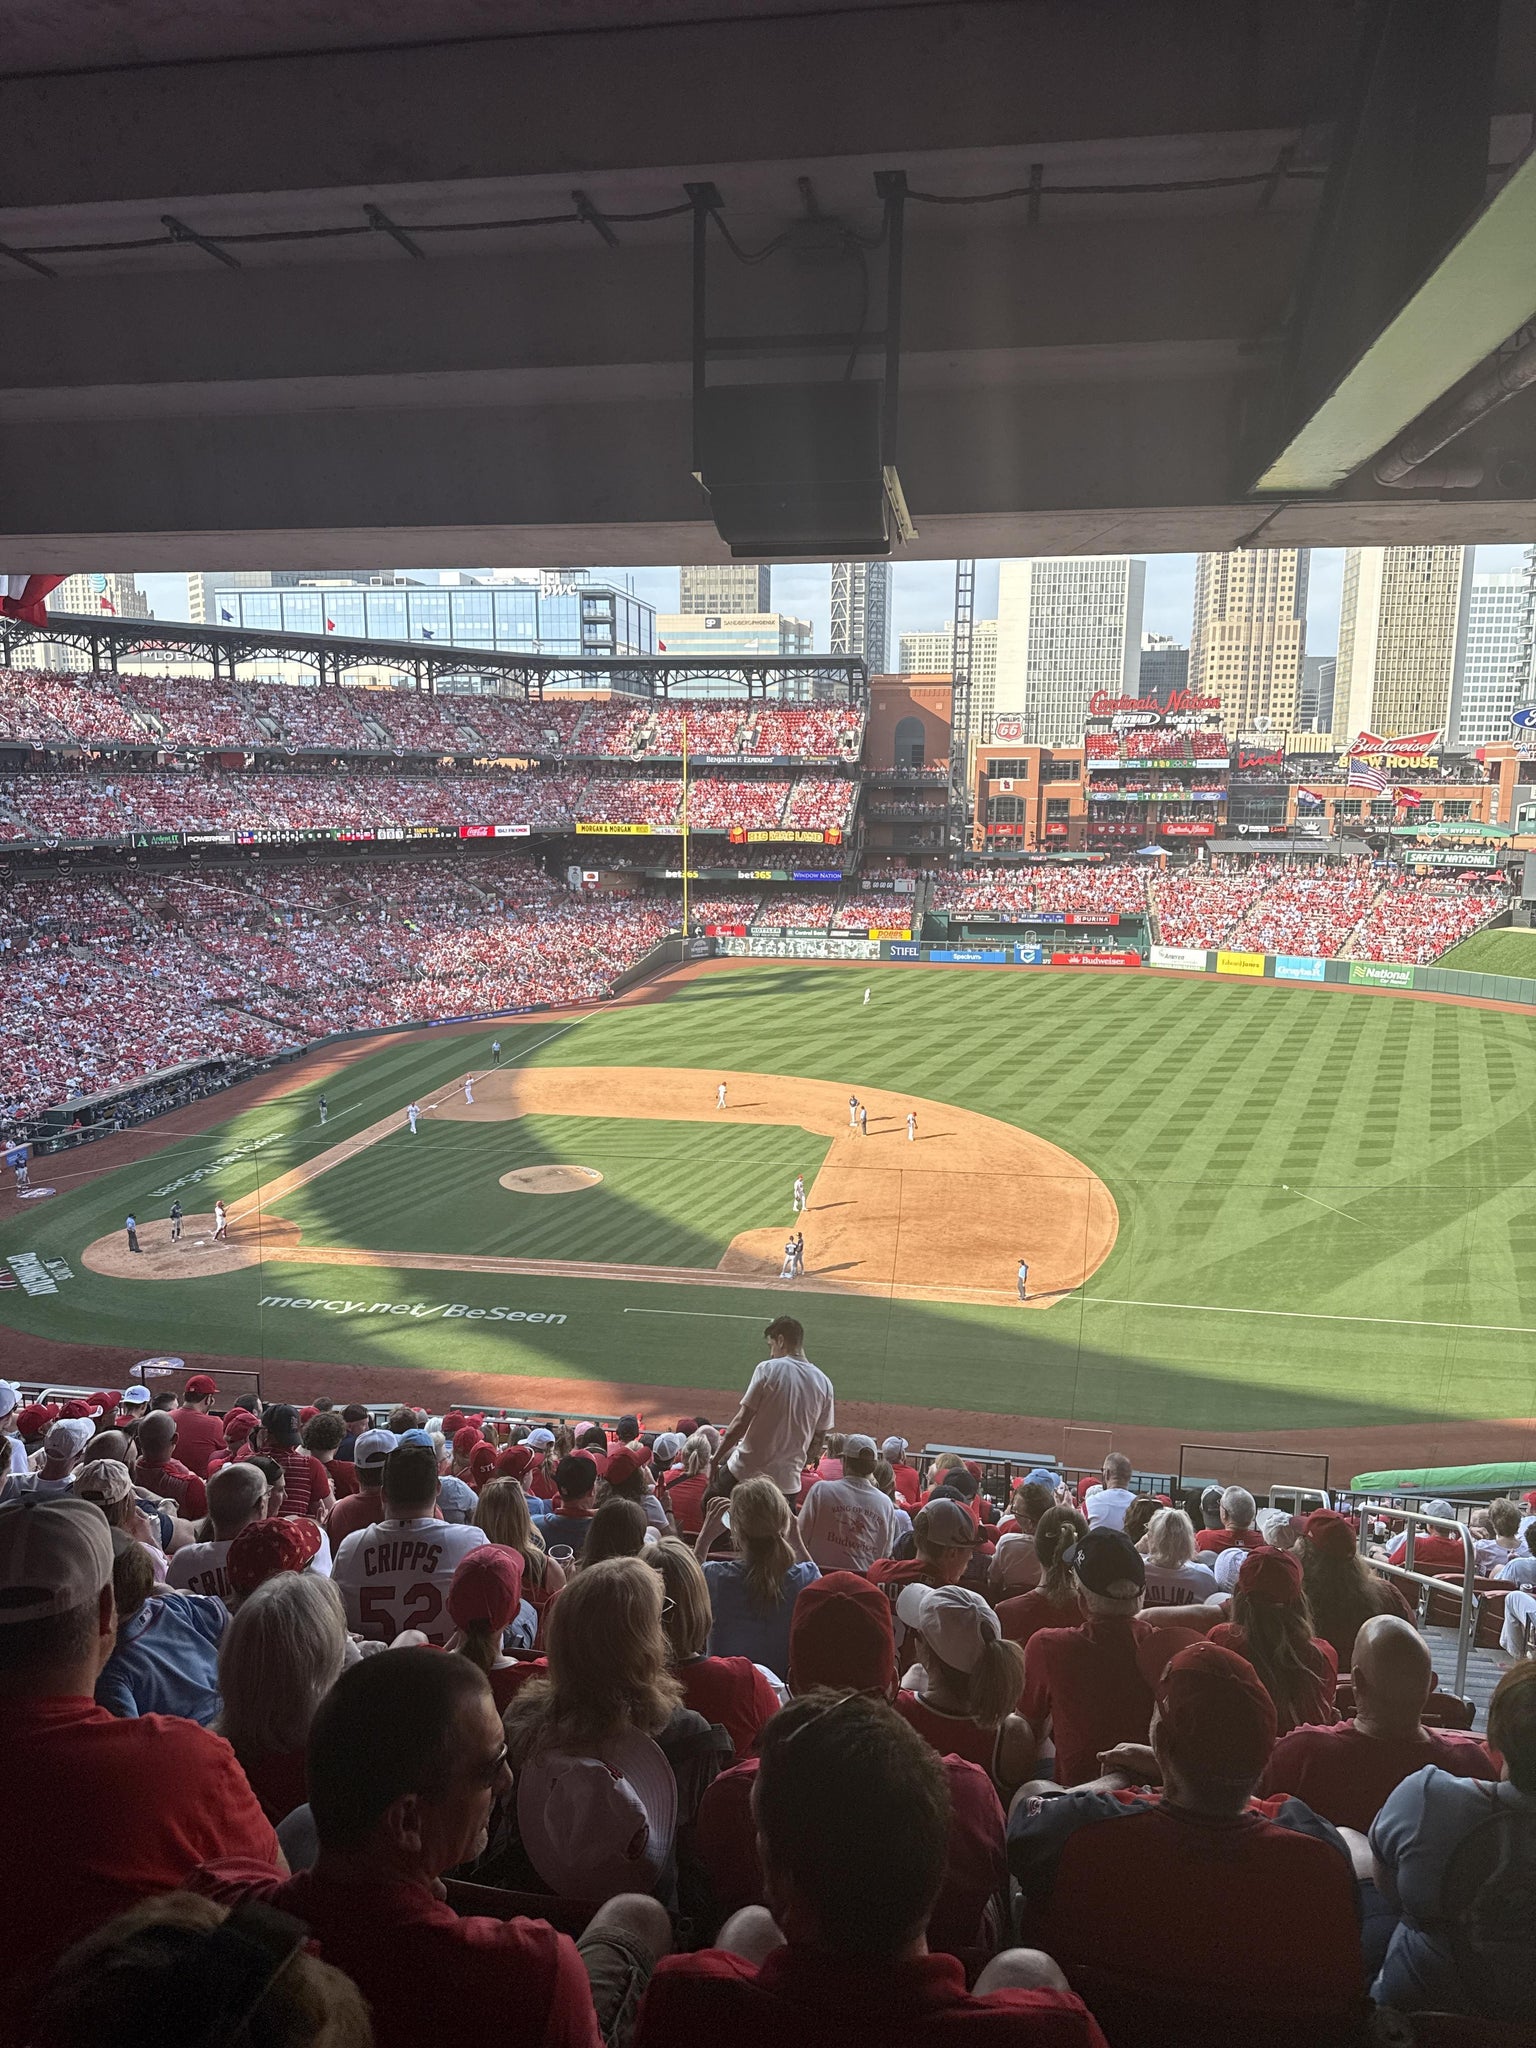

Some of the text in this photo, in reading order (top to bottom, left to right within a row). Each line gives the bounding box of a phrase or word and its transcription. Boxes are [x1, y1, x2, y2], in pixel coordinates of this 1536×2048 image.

[541, 584, 578, 600] pwc
[1090, 688, 1221, 715] Cardinals Nation
[1000, 725, 1018, 736] 66
[1351, 737, 1441, 753] Budweiser
[706, 755, 736, 763] BENJAMIN
[1386, 756, 1439, 768] HOUSE
[769, 831, 794, 841] MAC
[795, 831, 823, 842] LAND
[1410, 853, 1491, 864] SAFETY NATIONAL
[665, 869, 698, 878] bet365
[738, 871, 771, 879] bet365
[877, 930, 903, 938] DOBBS
[890, 946, 919, 956] STIFEL
[953, 953, 981, 961] Spectrum
[1082, 956, 1125, 965] Budweiser
[1366, 967, 1411, 979] National
[257, 1295, 568, 1325] mercy.net/BeSeen
[480, 1462, 495, 1472] STL
[364, 1541, 442, 1577] CRIPPS
[360, 1582, 444, 1647] 52
